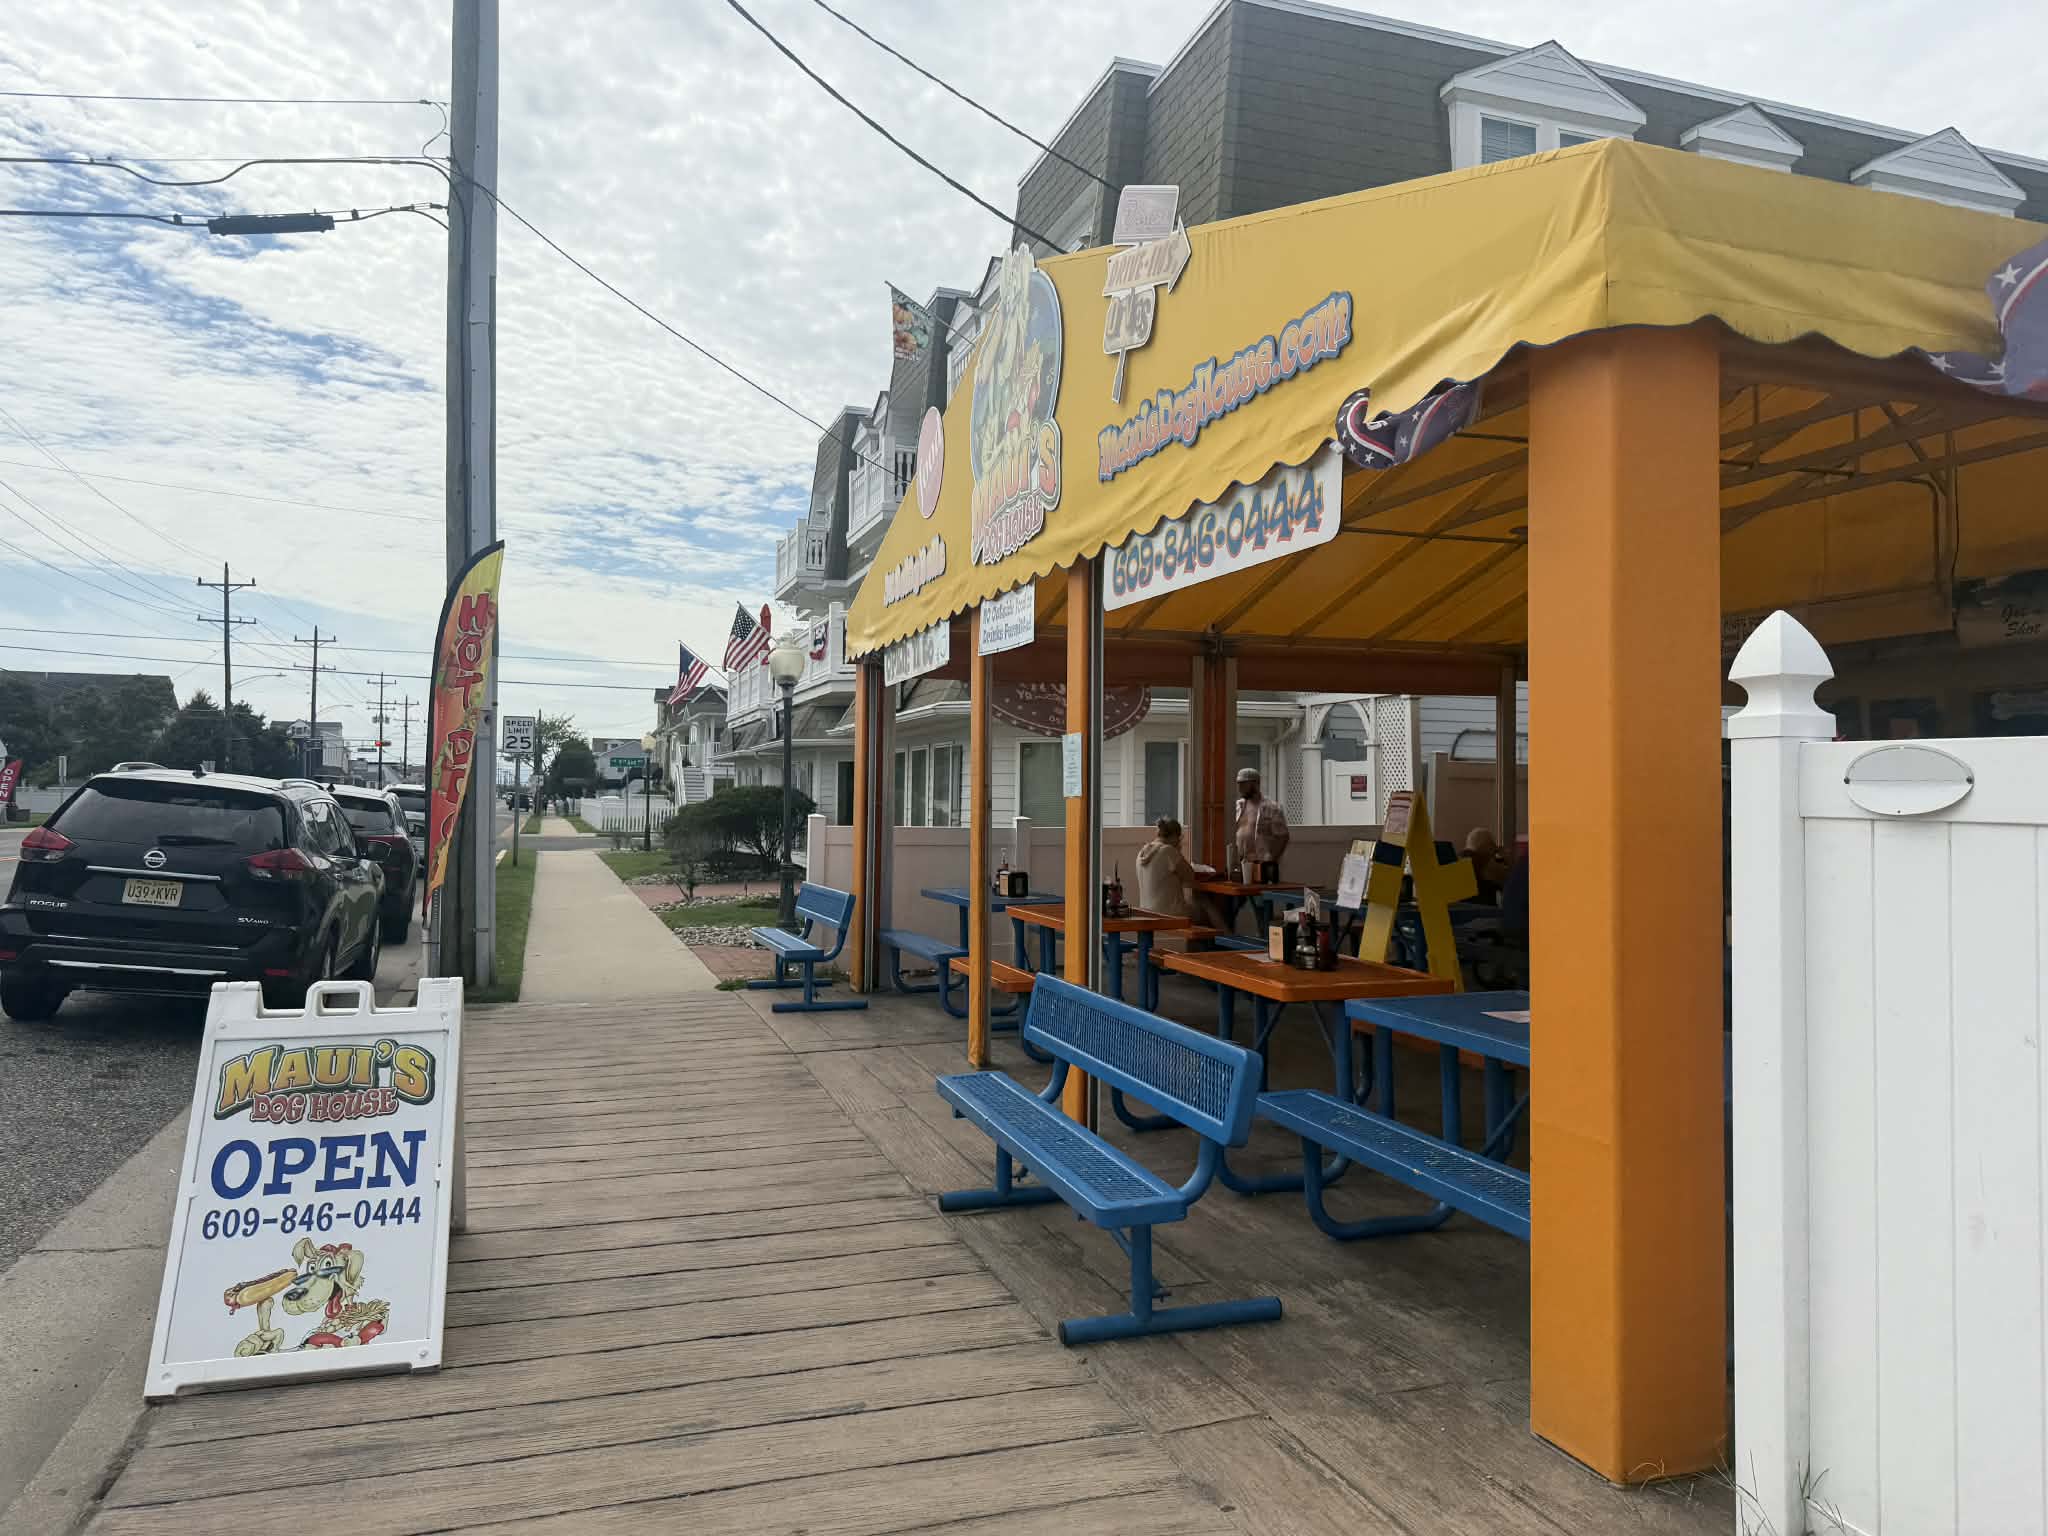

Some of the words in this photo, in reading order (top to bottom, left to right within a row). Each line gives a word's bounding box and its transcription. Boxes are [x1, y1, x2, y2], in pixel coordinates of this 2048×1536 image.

[456, 592, 490, 710] HOT
[505, 736, 532, 750] 25
[508, 726, 529, 734] LIMIT
[214, 1039, 435, 1120] MAUI'S
[250, 1093, 306, 1124] DOG
[307, 1086, 400, 1122] HOUSE
[211, 1130, 427, 1199] OPEN
[202, 1196, 421, 1240] 609-846-0444
